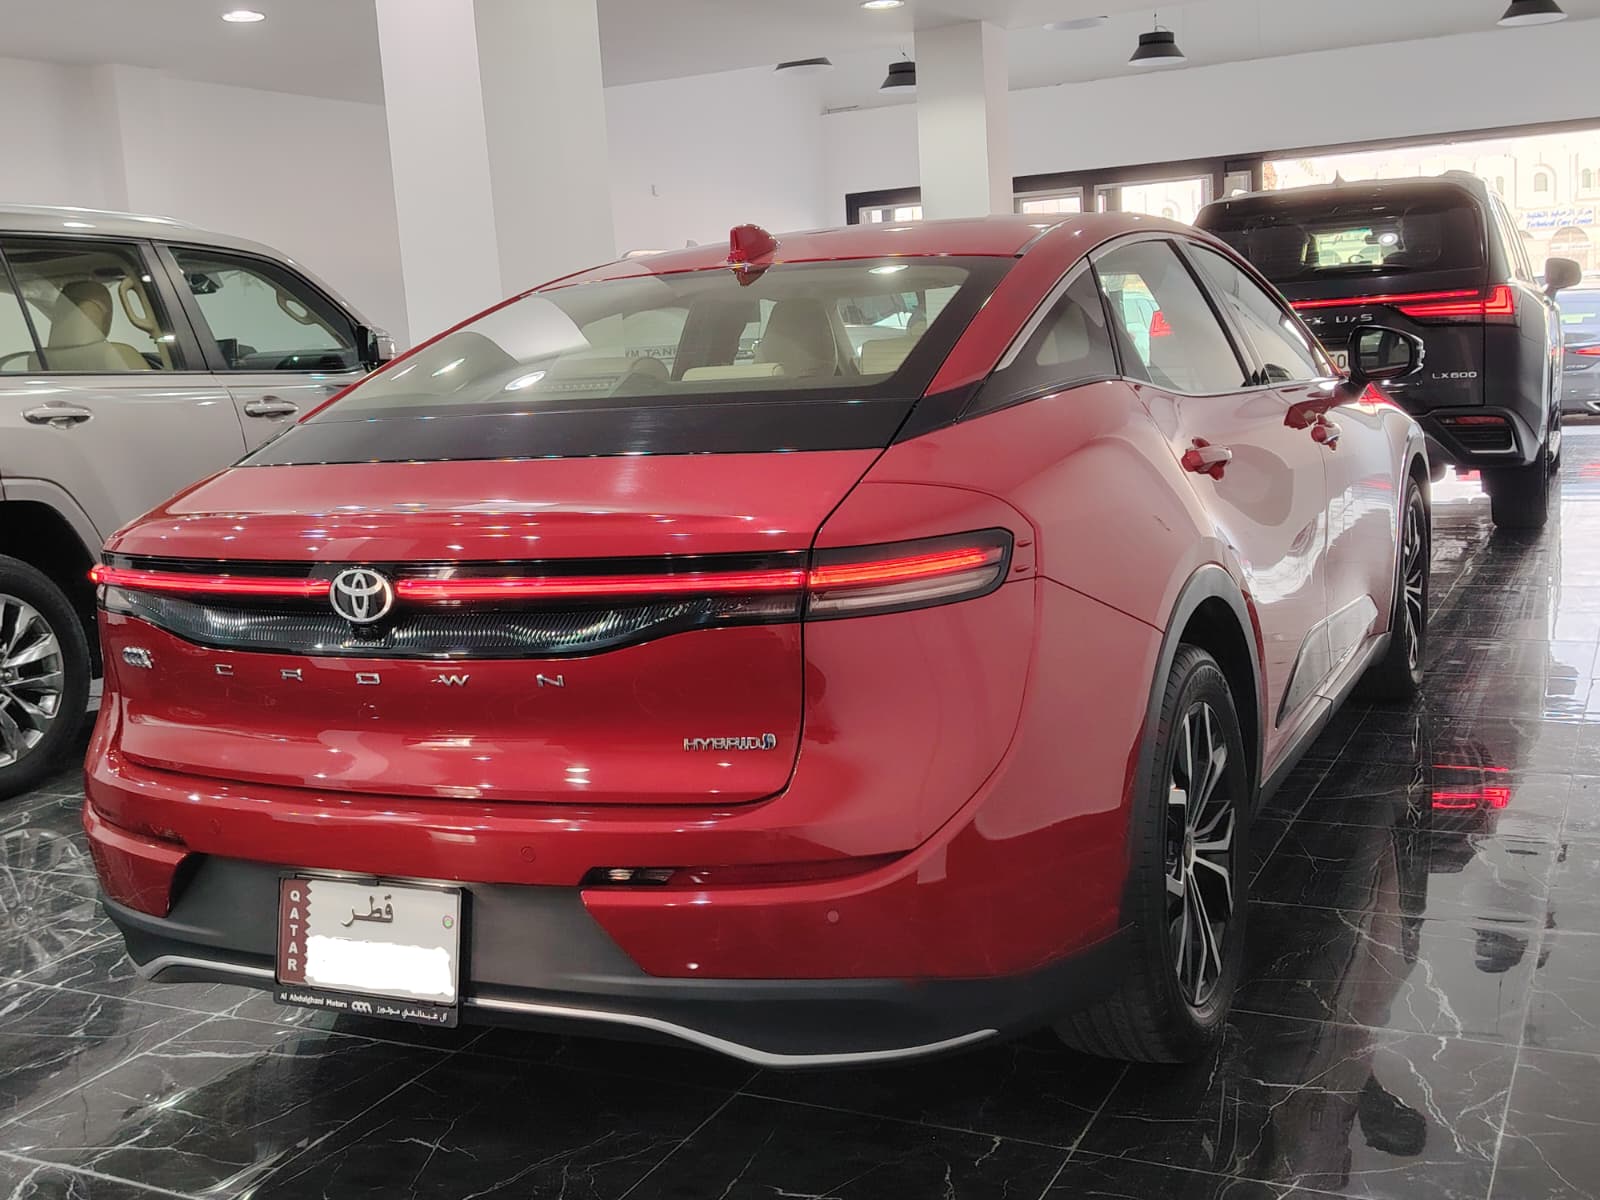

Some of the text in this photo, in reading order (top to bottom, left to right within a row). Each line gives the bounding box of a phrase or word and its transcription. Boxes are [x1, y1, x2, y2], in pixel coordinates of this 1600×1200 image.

[645, 348, 676, 358] TAN
[1432, 371, 1478, 380] LX600
[214, 663, 566, 689] CROWN
[683, 736, 763, 751] HYBRID
[341, 894, 394, 928] قطر
[287, 889, 301, 972] QATAR
[279, 991, 288, 1001] Al
[289, 993, 325, 1006] Abdulghani
[326, 998, 348, 1010] Motors
